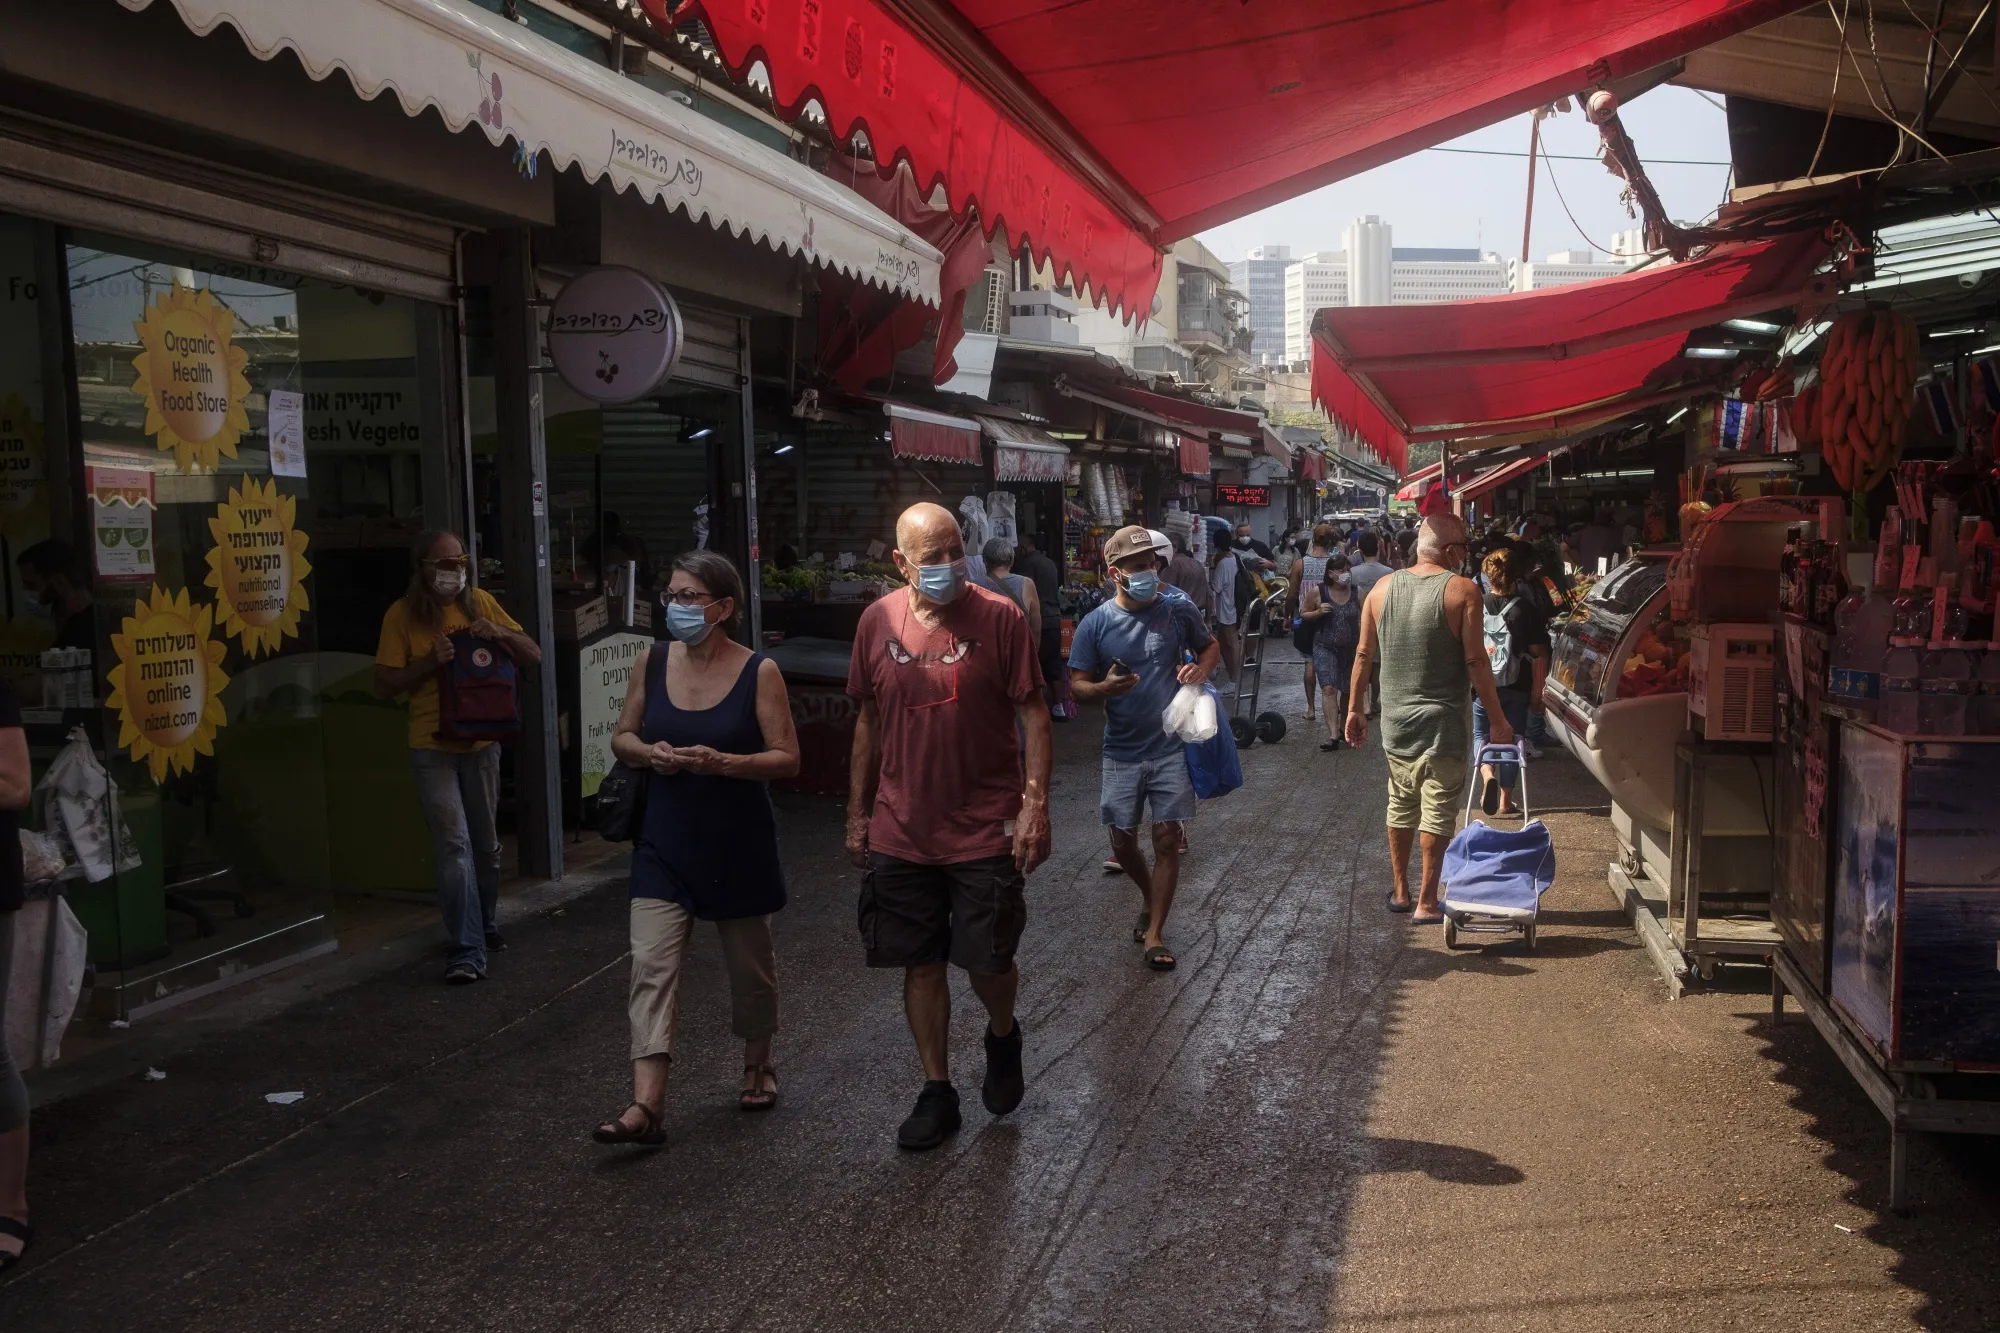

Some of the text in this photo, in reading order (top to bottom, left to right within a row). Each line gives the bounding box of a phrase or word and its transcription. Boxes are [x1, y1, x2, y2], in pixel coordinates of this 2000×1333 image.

[607, 128, 702, 196] ניצת הדובדבן
[549, 309, 669, 337] ניצת הדובדבן
[164, 330, 216, 358] Organic
[172, 361, 213, 384] Health
[161, 389, 227, 414] Food Store
[335, 391, 402, 415] ירקנייה
[238, 508, 272, 529] ייעוץ
[227, 532, 285, 549] נטורופתי
[234, 555, 281, 574] מקצועי
[238, 576, 281, 593] nutritional
[237, 595, 285, 613] counseling
[135, 632, 196, 656] משלוחים
[591, 645, 619, 667] וירקות
[603, 667, 633, 686] ורגניים
[147, 682, 192, 705] online
[608, 696, 625, 712] Orga
[144, 710, 198, 732] nizat.com
[588, 722, 604, 739] Fruit
